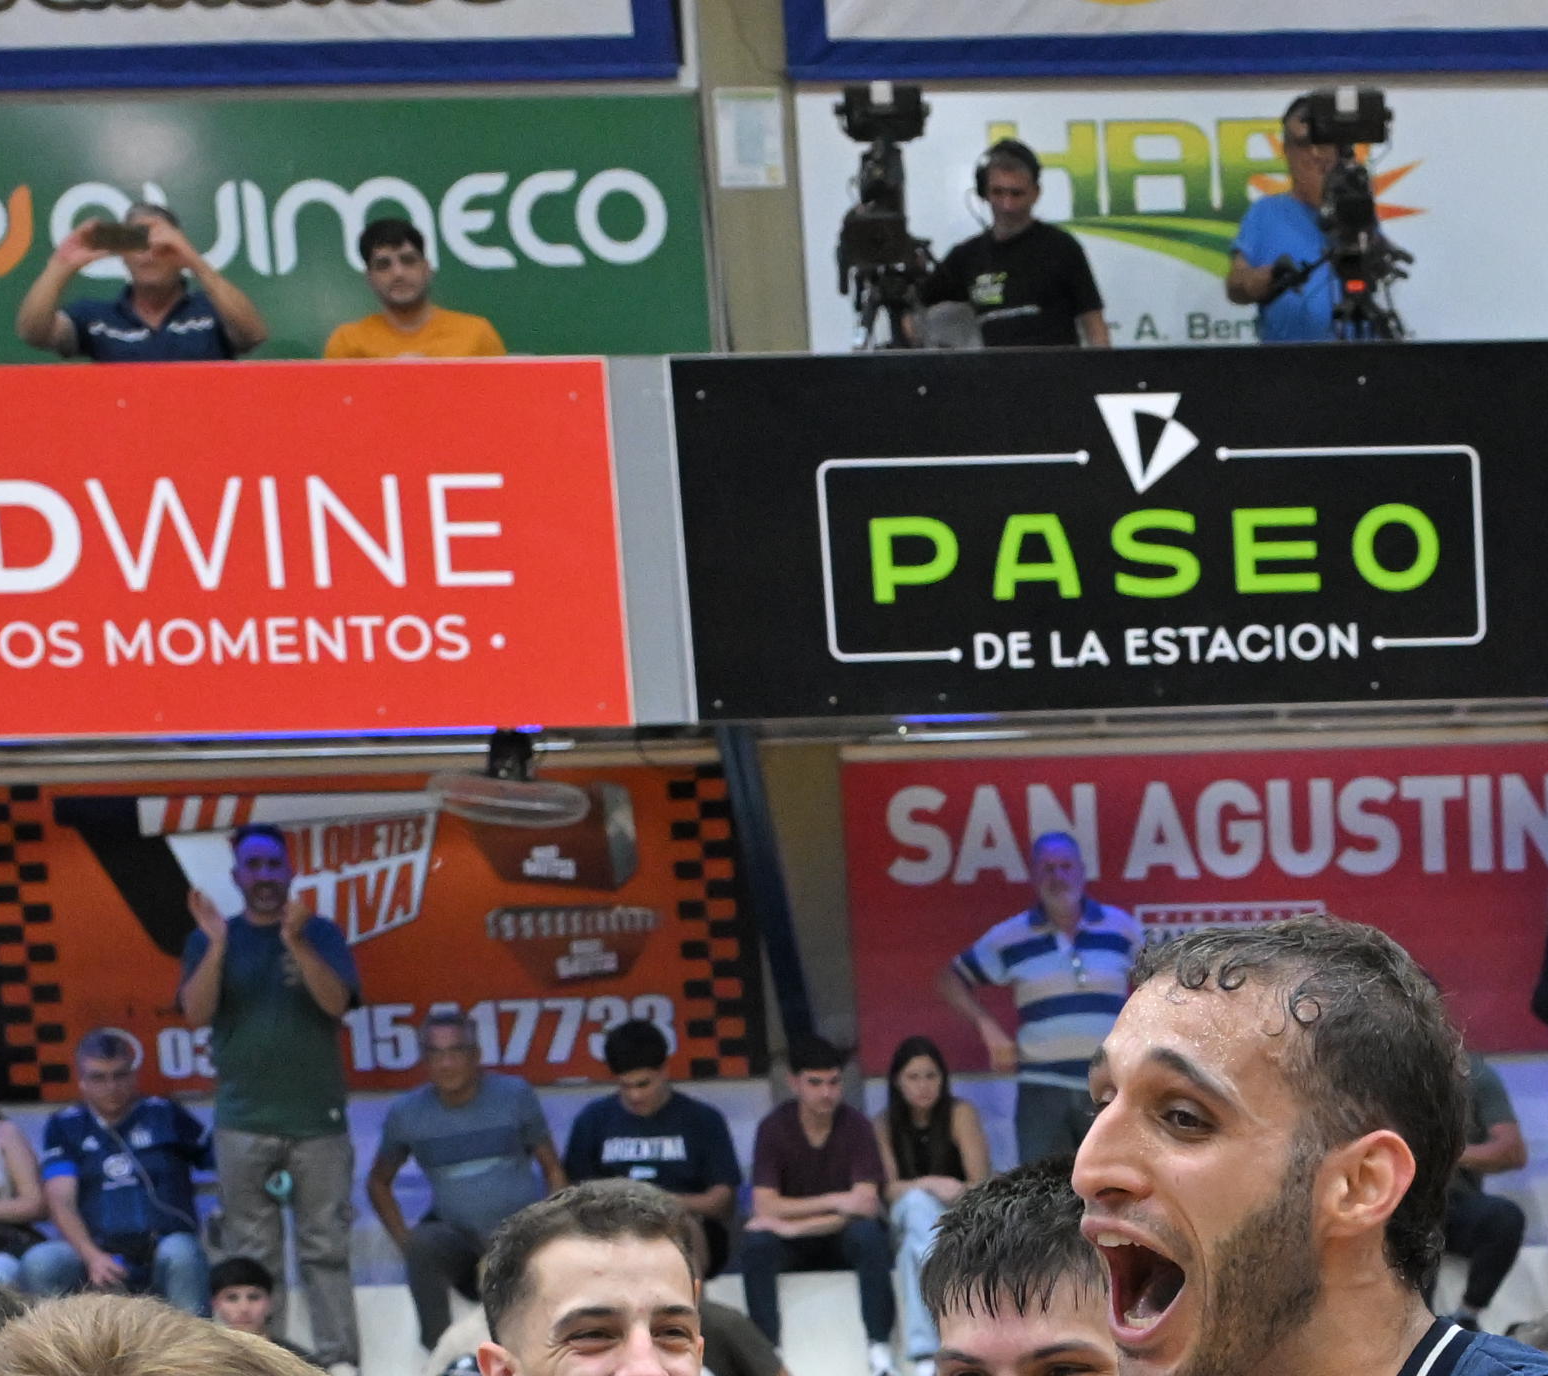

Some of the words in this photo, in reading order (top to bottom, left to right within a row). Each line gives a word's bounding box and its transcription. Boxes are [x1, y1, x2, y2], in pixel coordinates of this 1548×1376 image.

[868, 502, 1440, 604] PASEO
[103, 612, 471, 668] MOMENTOS
[973, 630, 1035, 669] DE
[1052, 628, 1111, 667] LA
[1125, 621, 1360, 666] ESTACION
[885, 785, 1102, 886] SAN
